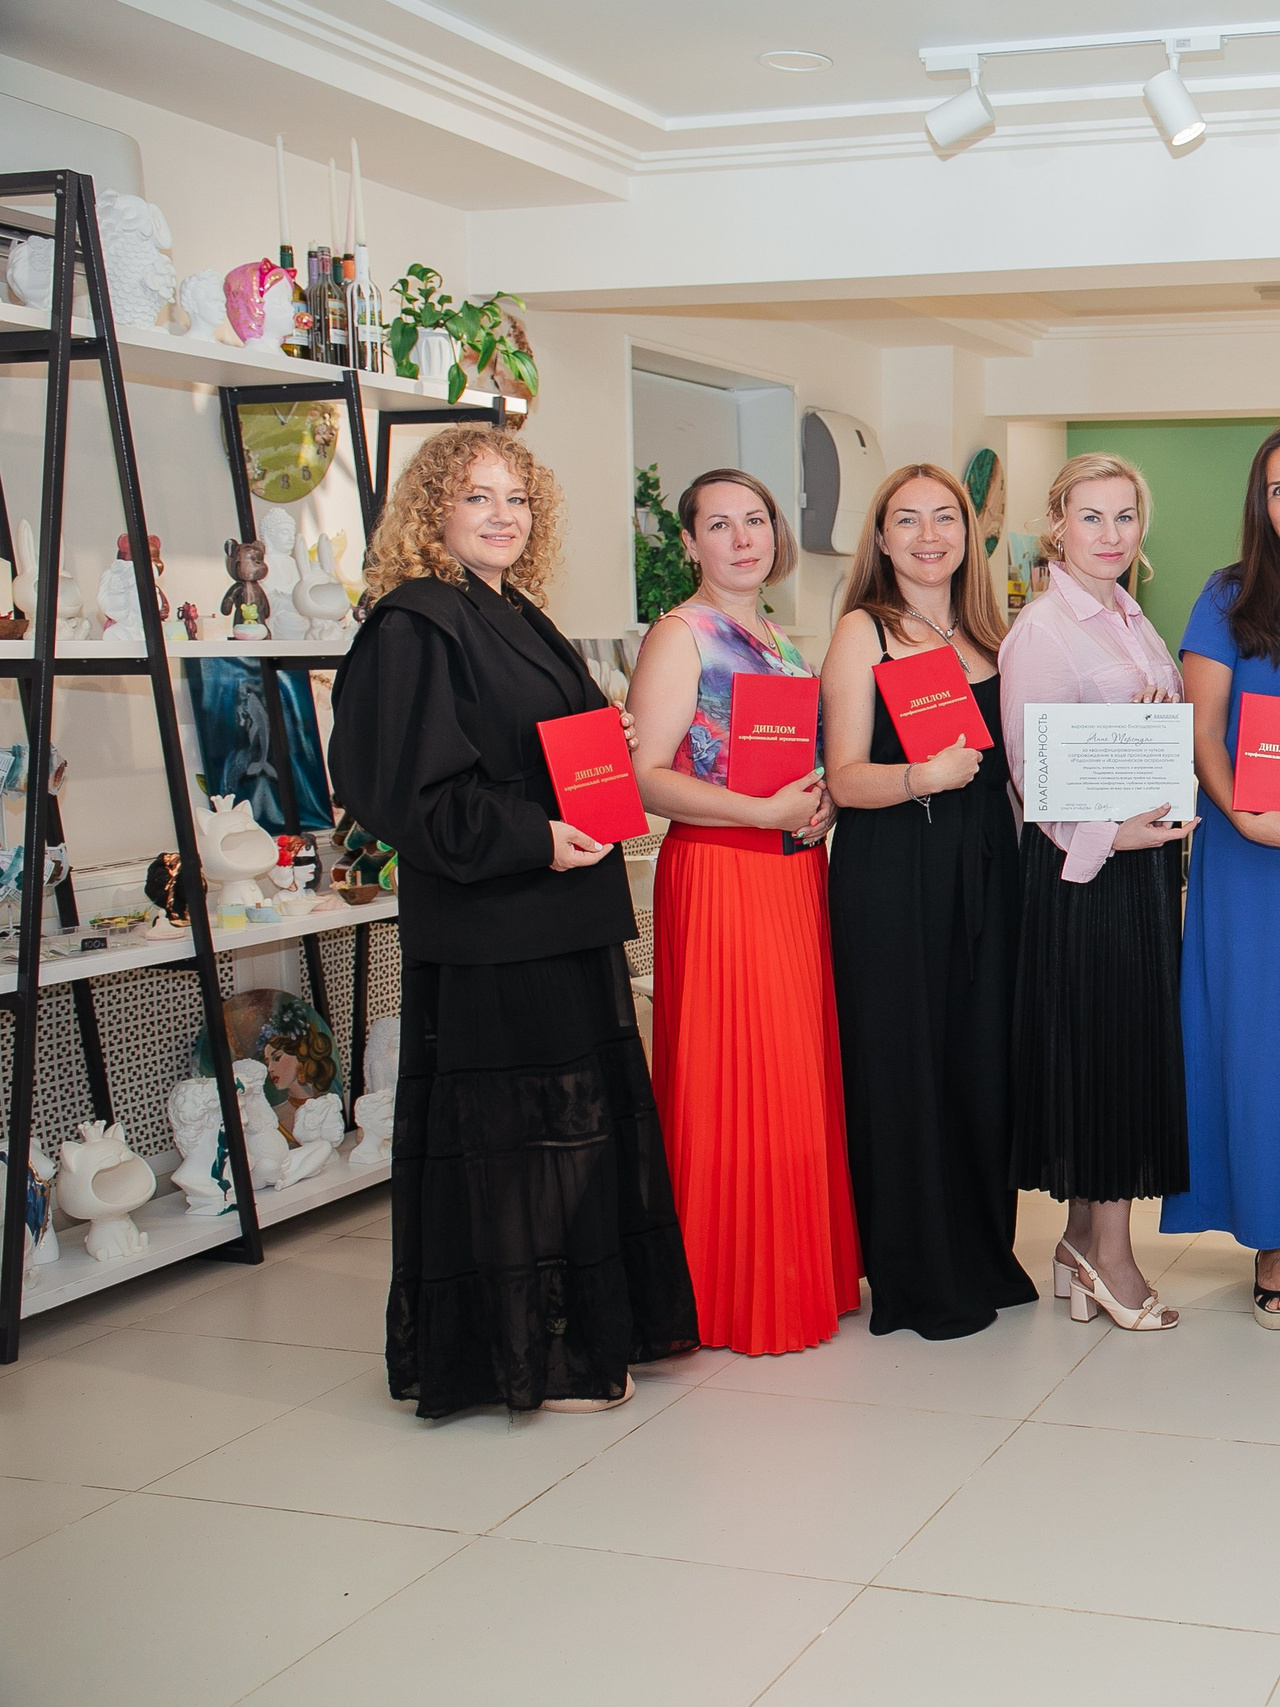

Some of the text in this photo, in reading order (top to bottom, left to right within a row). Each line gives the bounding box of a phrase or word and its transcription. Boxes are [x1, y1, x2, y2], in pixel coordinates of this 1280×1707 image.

[910, 690, 951, 709] ДИПЛОМ
[752, 725, 796, 734] ДИПЛОМ
[1039, 713, 1048, 811] БЛАГОДАРНОСТЬ
[575, 764, 613, 782] ДИПЛОМ
